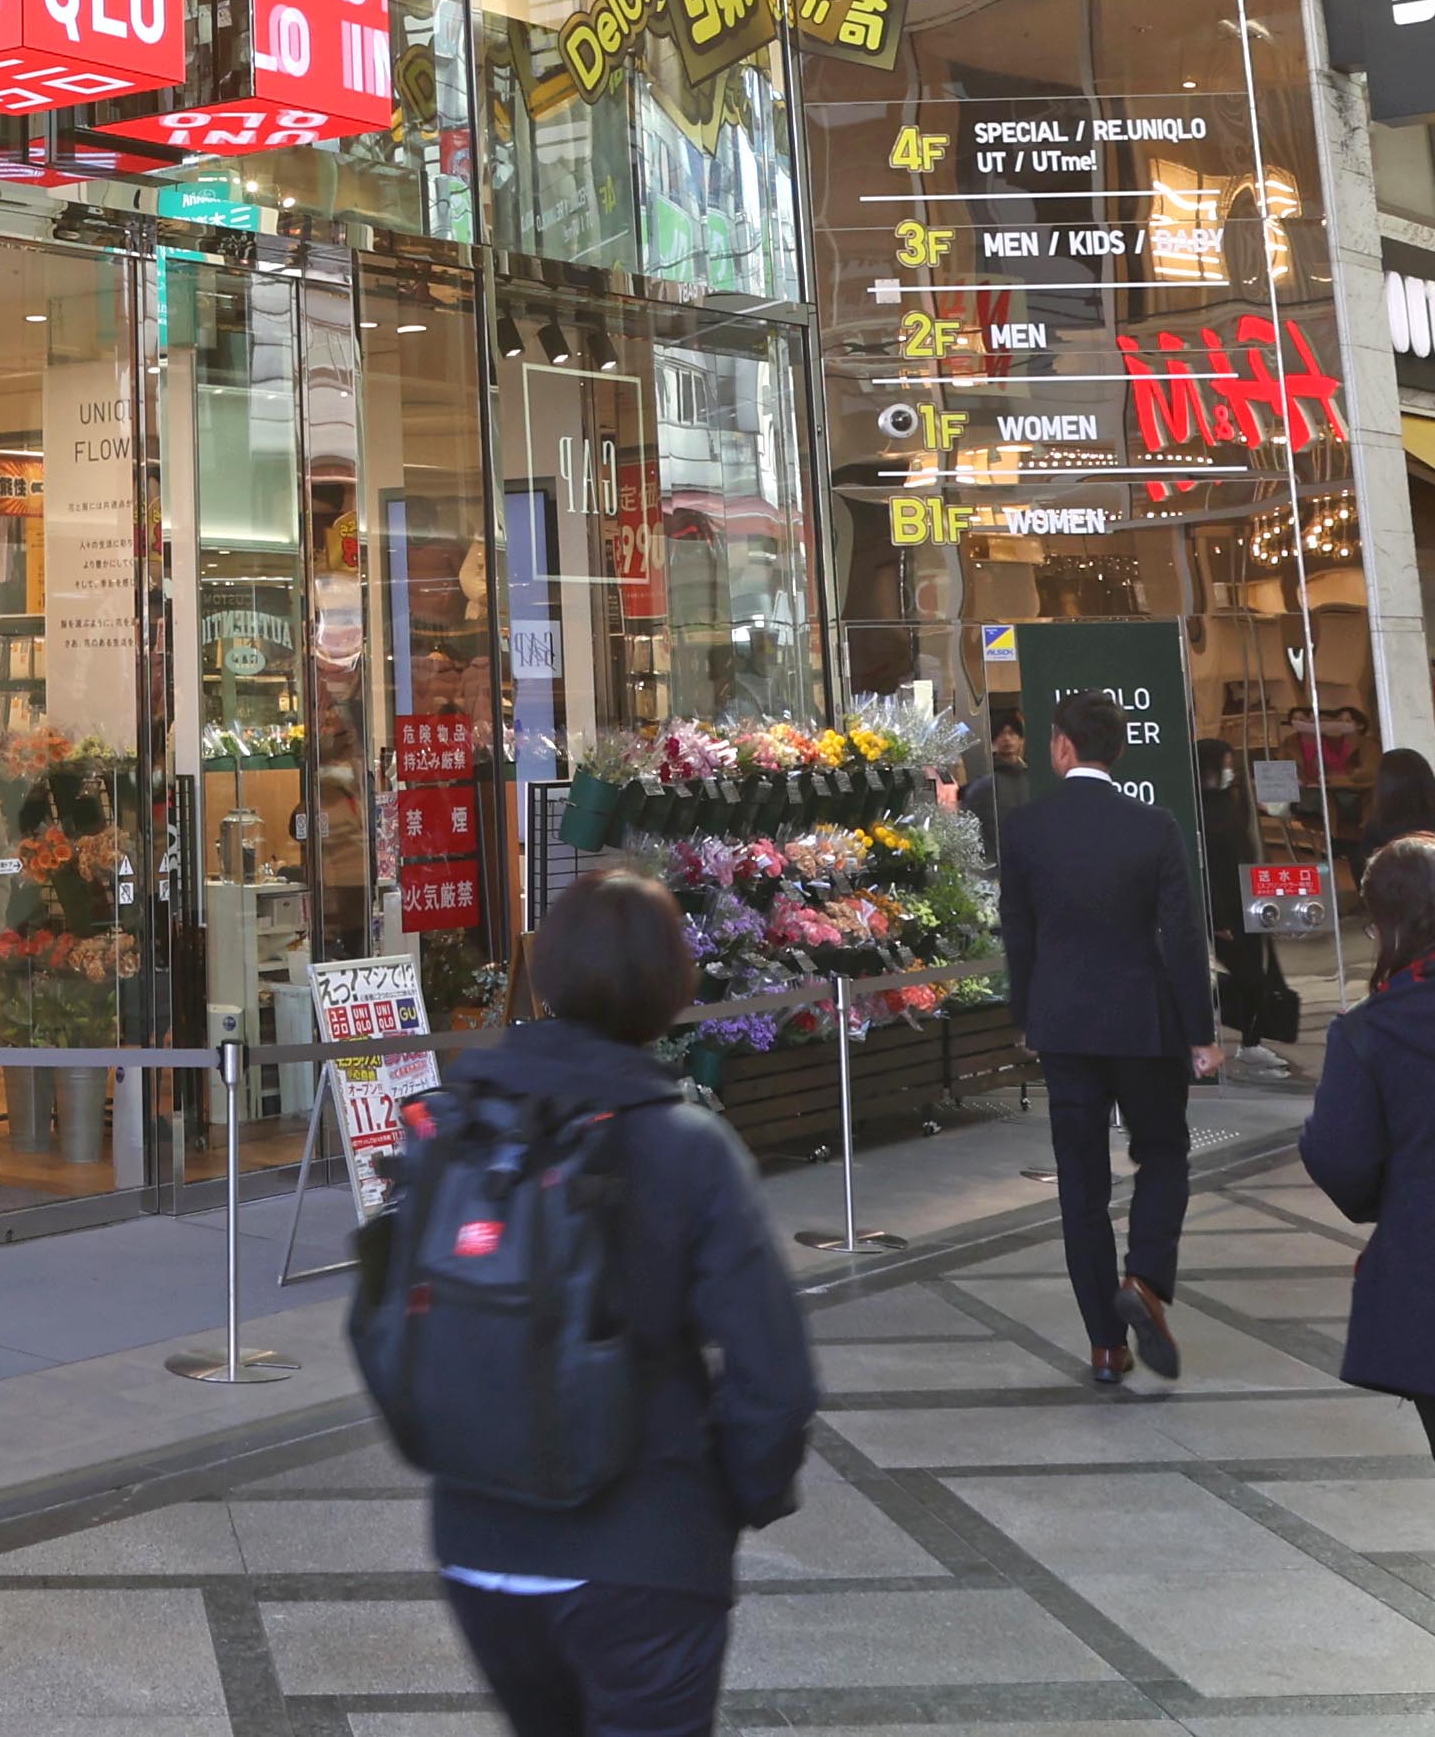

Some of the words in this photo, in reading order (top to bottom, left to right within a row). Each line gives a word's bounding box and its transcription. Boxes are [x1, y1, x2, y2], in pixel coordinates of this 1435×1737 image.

[890, 126, 950, 172] 4F
[975, 122, 1068, 143] SPECIAL
[1093, 118, 1206, 141] RE.UNIQLO
[977, 152, 1005, 173] UT
[1031, 151, 1097, 172] UTme!
[896, 220, 953, 268] 3F
[984, 233, 1039, 258] MEN
[1069, 231, 1125, 256] KIDS
[1154, 228, 1226, 254] BABY
[902, 313, 962, 359] 2F
[990, 324, 1047, 349] MEN
[919, 404, 968, 451] 1F
[997, 416, 1097, 442] WOMEN
[74, 437, 131, 463] FLOW
[891, 497, 974, 546] B1F
[1005, 509, 1106, 535] WOMEN
[402, 723, 468, 746] 危険物品
[402, 750, 468, 773] 持込み厳禁
[406, 806, 469, 837] 禁煙
[404, 879, 475, 912] 火気厳禁
[352, 1007, 369, 1020] UNI
[375, 1004, 392, 1017] UNI
[378, 1016, 394, 1031] QLO
[399, 1006, 417, 1022] GU
[355, 1019, 372, 1033] QLO
[350, 1094, 398, 1134] 11.2
